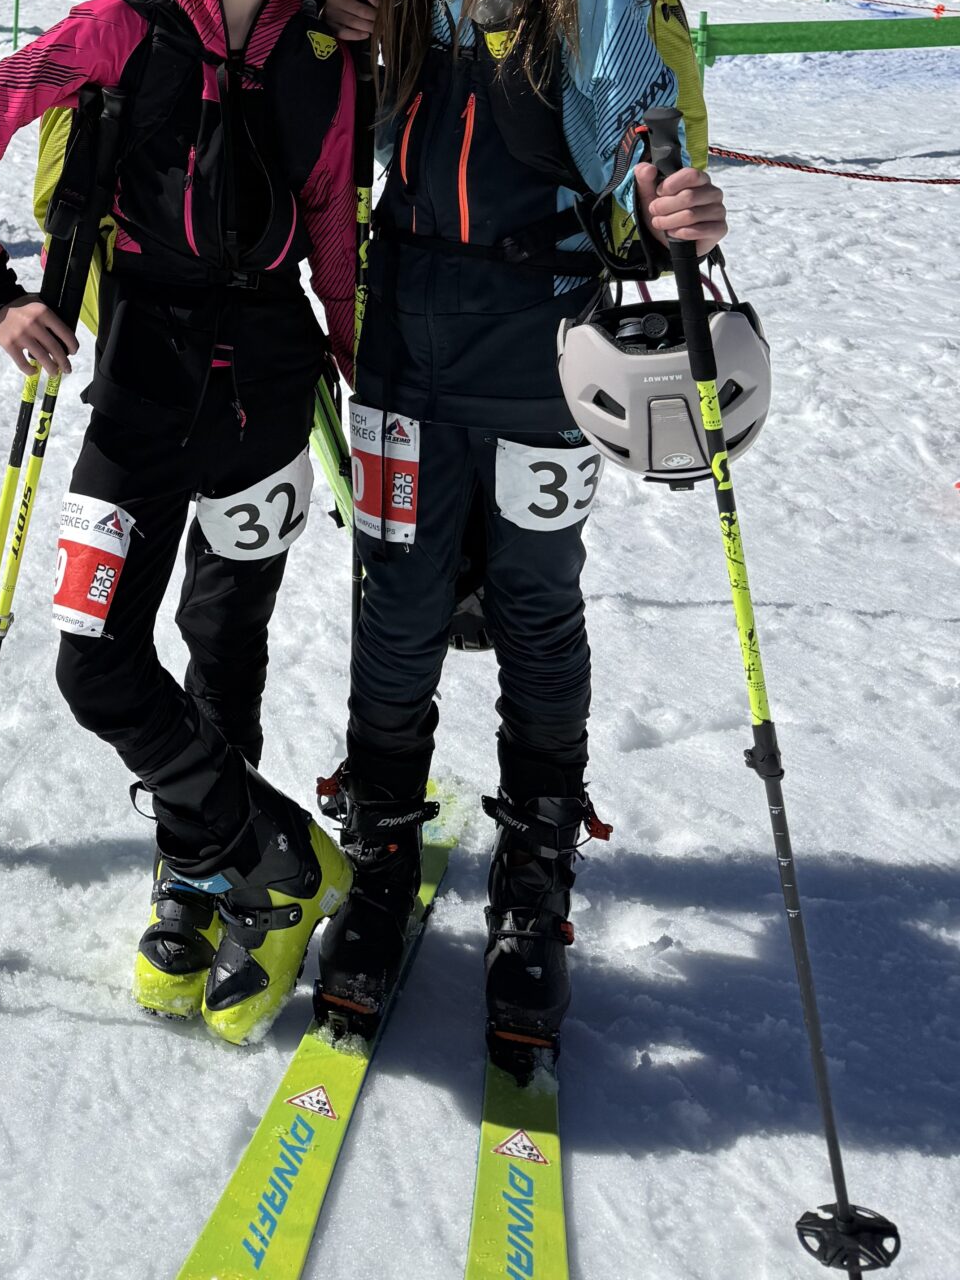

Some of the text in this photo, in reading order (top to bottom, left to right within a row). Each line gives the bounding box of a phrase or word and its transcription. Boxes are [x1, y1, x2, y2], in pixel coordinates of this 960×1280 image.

[643, 374, 683, 383] MAMMUT
[224, 482, 304, 550] 32
[527, 453, 601, 519] 33
[12, 482, 32, 560] SCOTT
[241, 1114, 316, 1271] DYNAFIT
